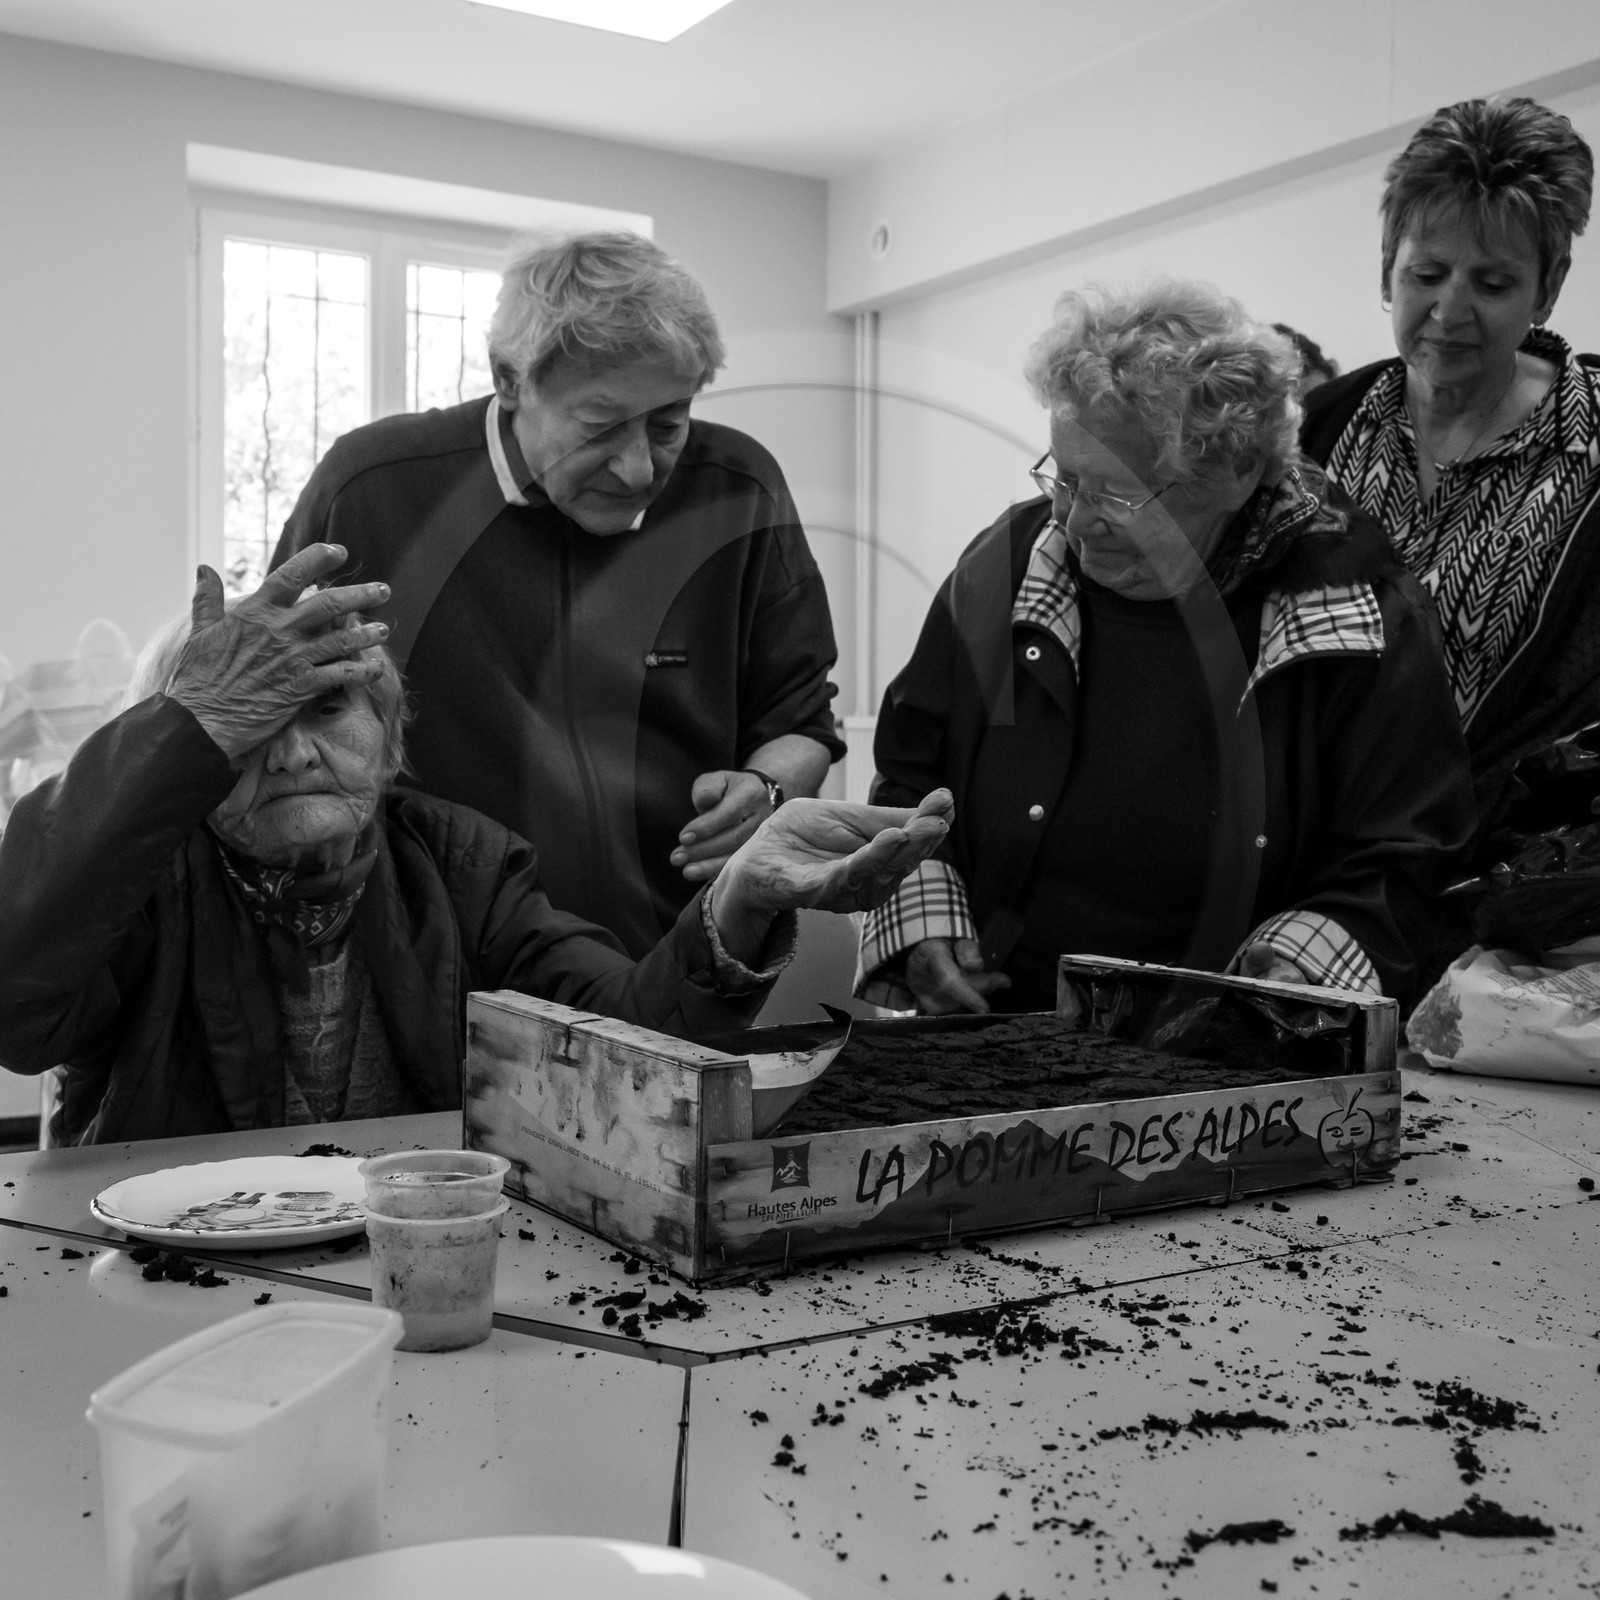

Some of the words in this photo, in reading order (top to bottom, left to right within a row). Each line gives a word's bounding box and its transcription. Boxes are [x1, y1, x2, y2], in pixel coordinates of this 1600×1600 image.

[856, 1145, 905, 1205] LA
[925, 1122, 1094, 1197] POMME
[1108, 1111, 1182, 1172] DES
[1193, 1096, 1304, 1163] ALPES
[747, 1201, 796, 1218] Hautes
[800, 1196, 838, 1212] Alpes
